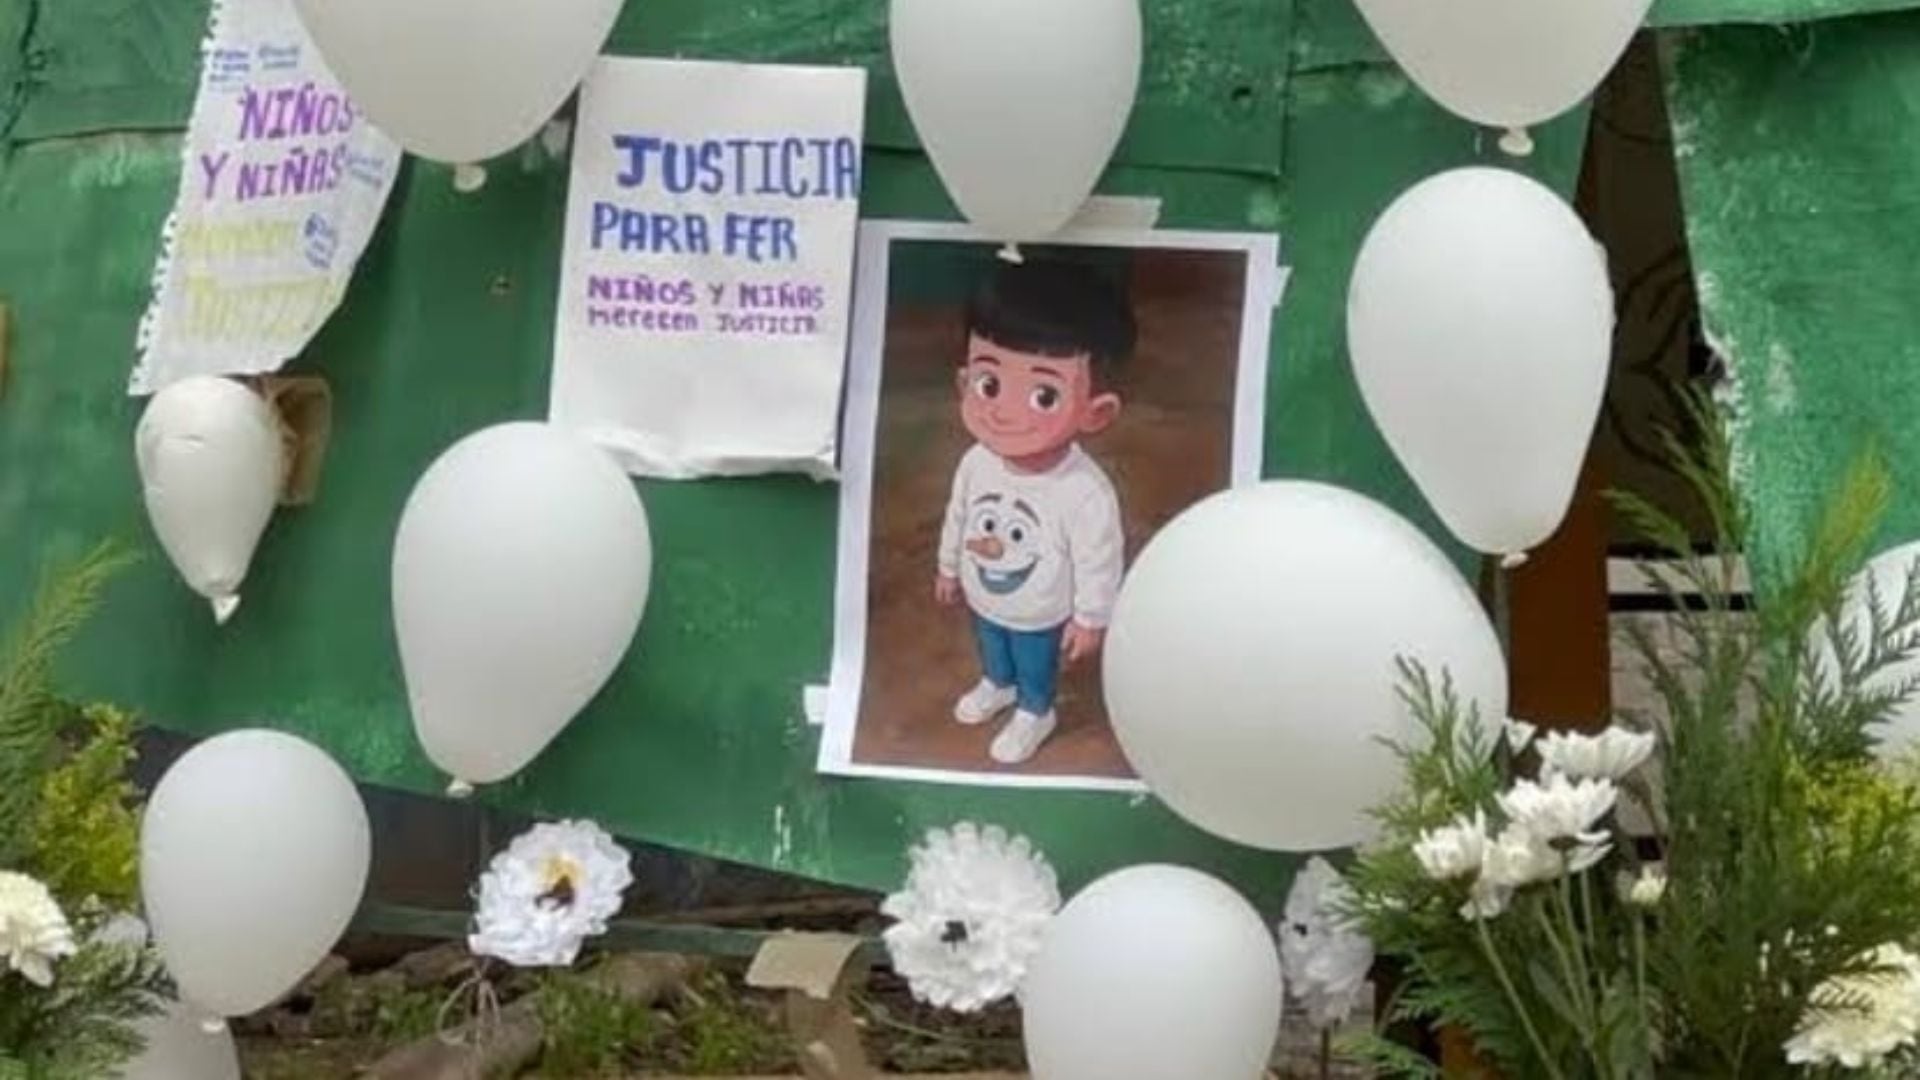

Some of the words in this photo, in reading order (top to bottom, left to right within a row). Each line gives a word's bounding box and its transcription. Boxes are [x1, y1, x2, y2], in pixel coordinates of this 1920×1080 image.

[238, 82, 353, 141] NIÑOS
[200, 152, 229, 199] Y
[236, 144, 347, 203] NIÑAS
[613, 134, 859, 199] JUSTICIA
[591, 202, 709, 255] PARA
[723, 212, 797, 262] FER
[588, 274, 697, 306] NIÑOS
[708, 282, 724, 306] Y
[738, 282, 824, 311] NIÑAS
